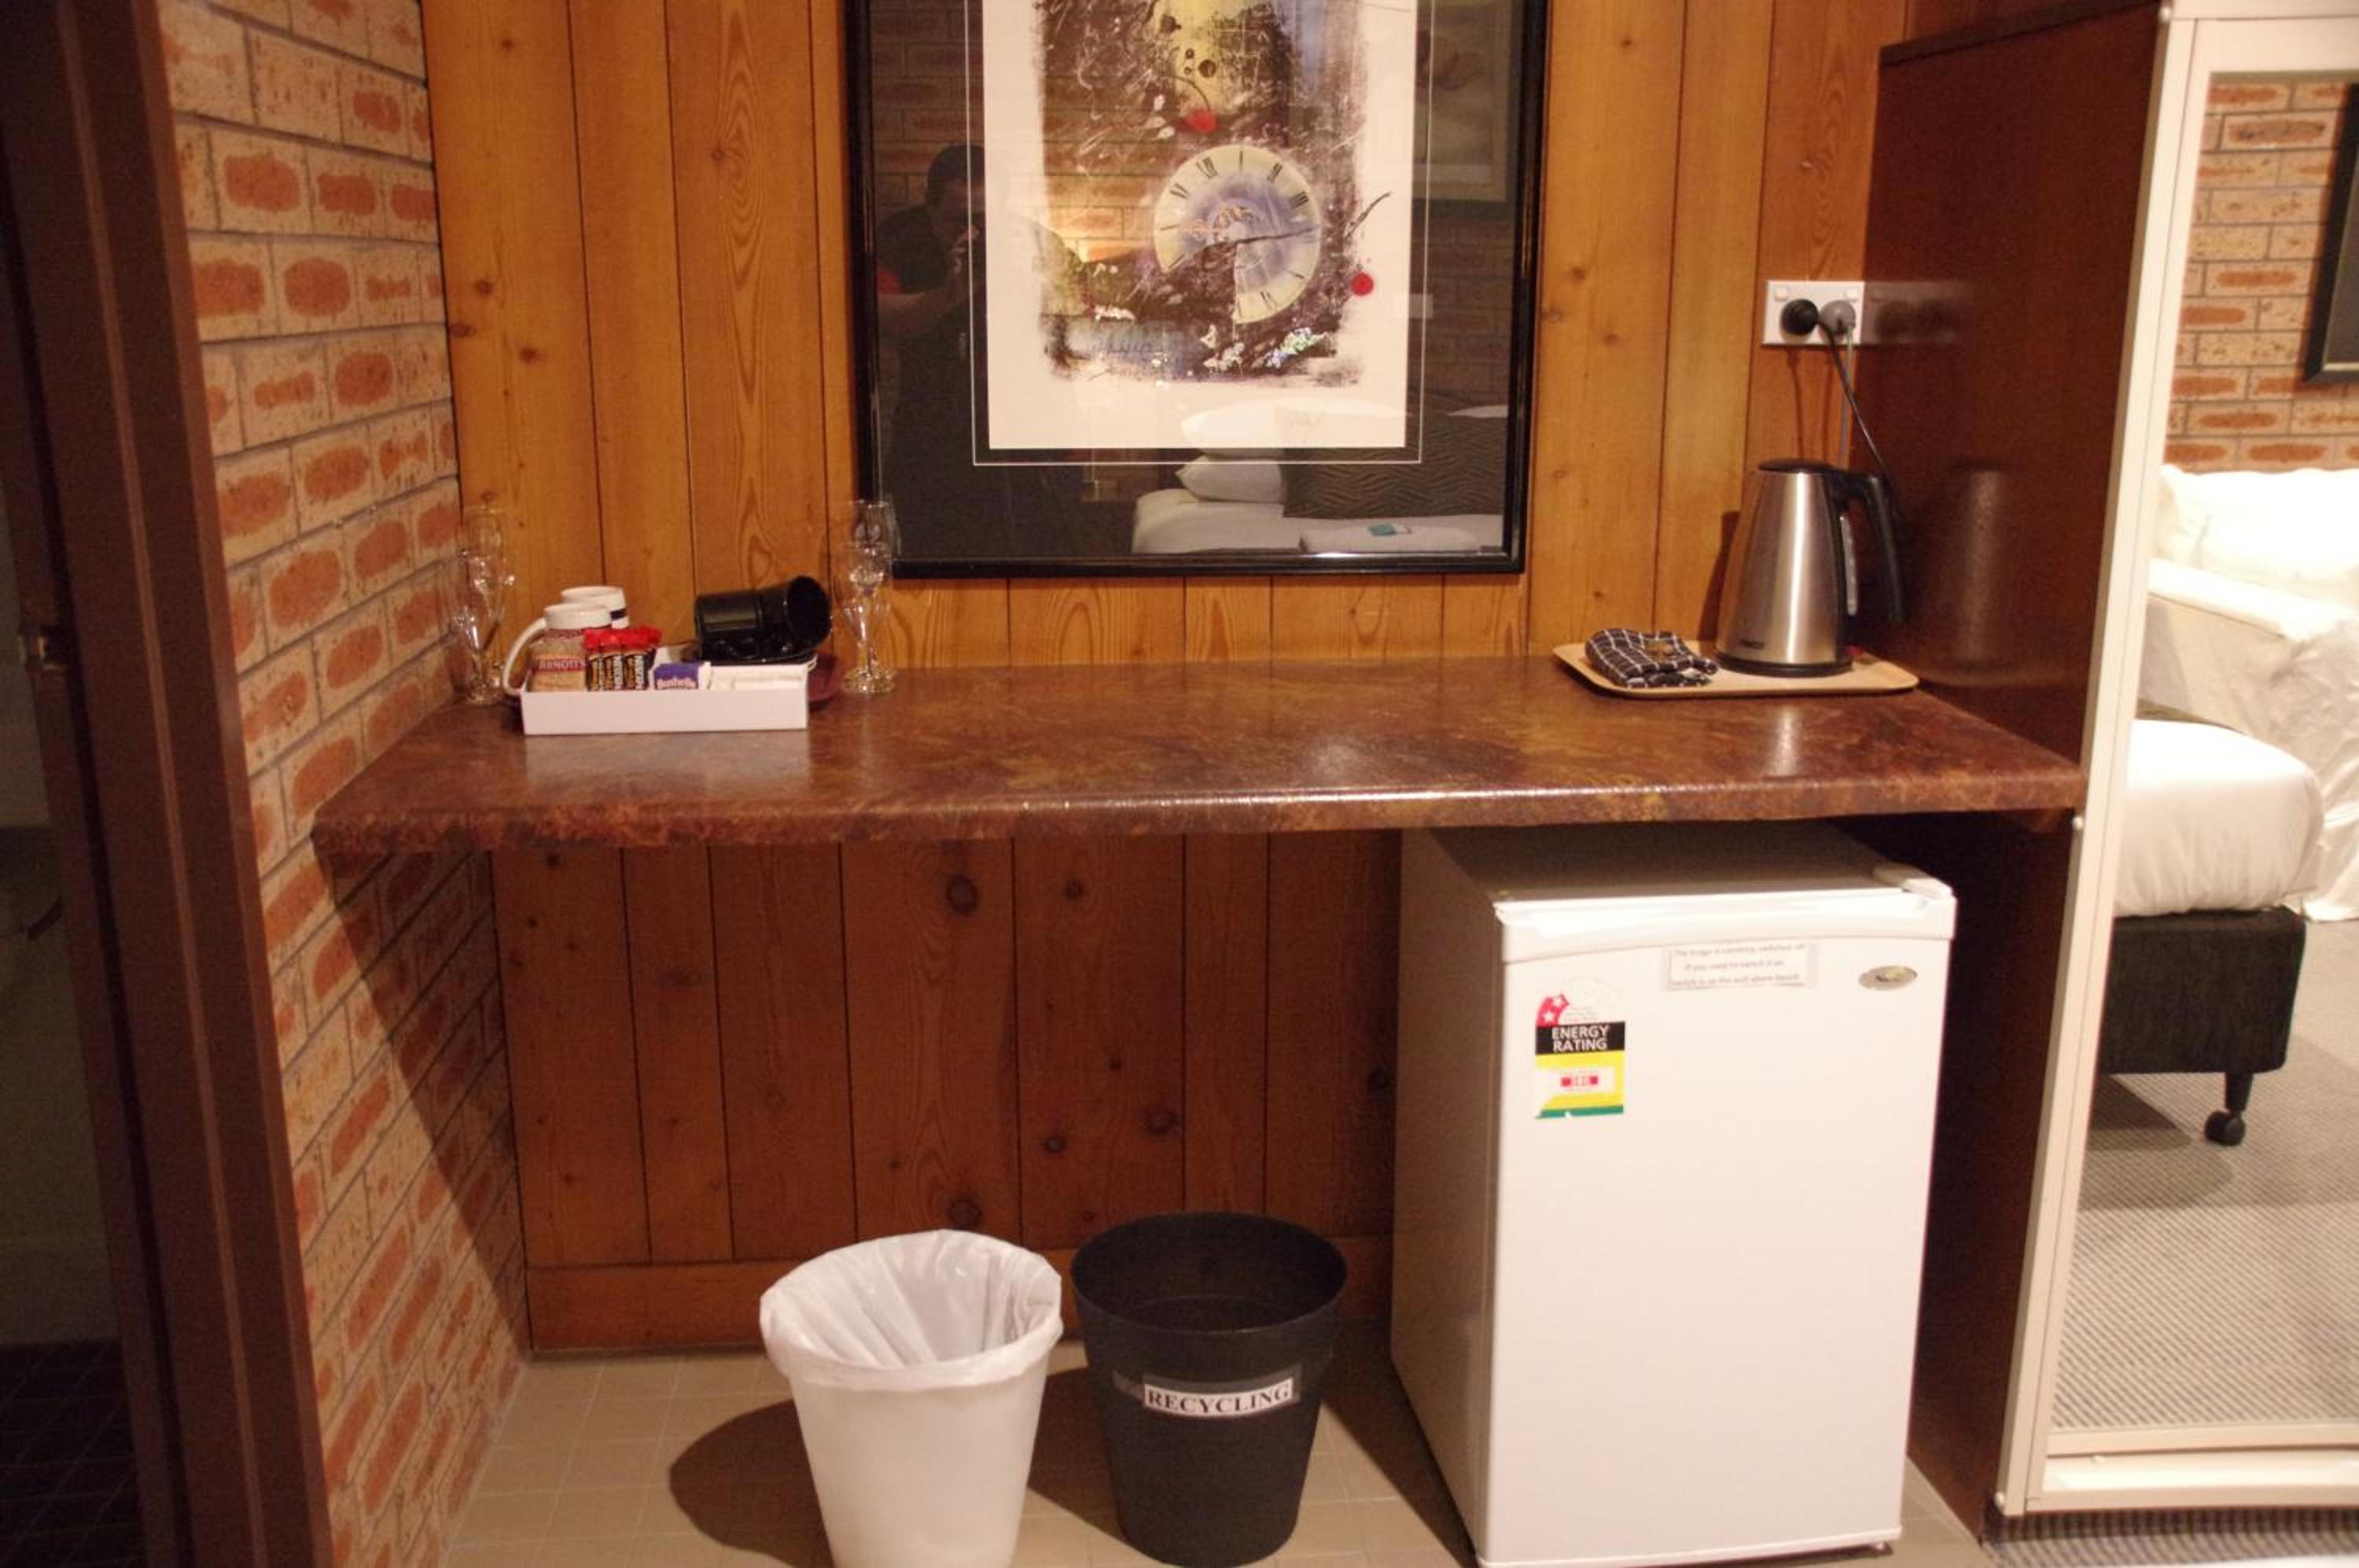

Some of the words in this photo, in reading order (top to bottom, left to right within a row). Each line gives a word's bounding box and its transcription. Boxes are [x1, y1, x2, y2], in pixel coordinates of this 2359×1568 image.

[1551, 1025, 1610, 1040] ENERGY
[1553, 1038, 1608, 1052] RATING
[1148, 1383, 1290, 1413] RECYCLING
